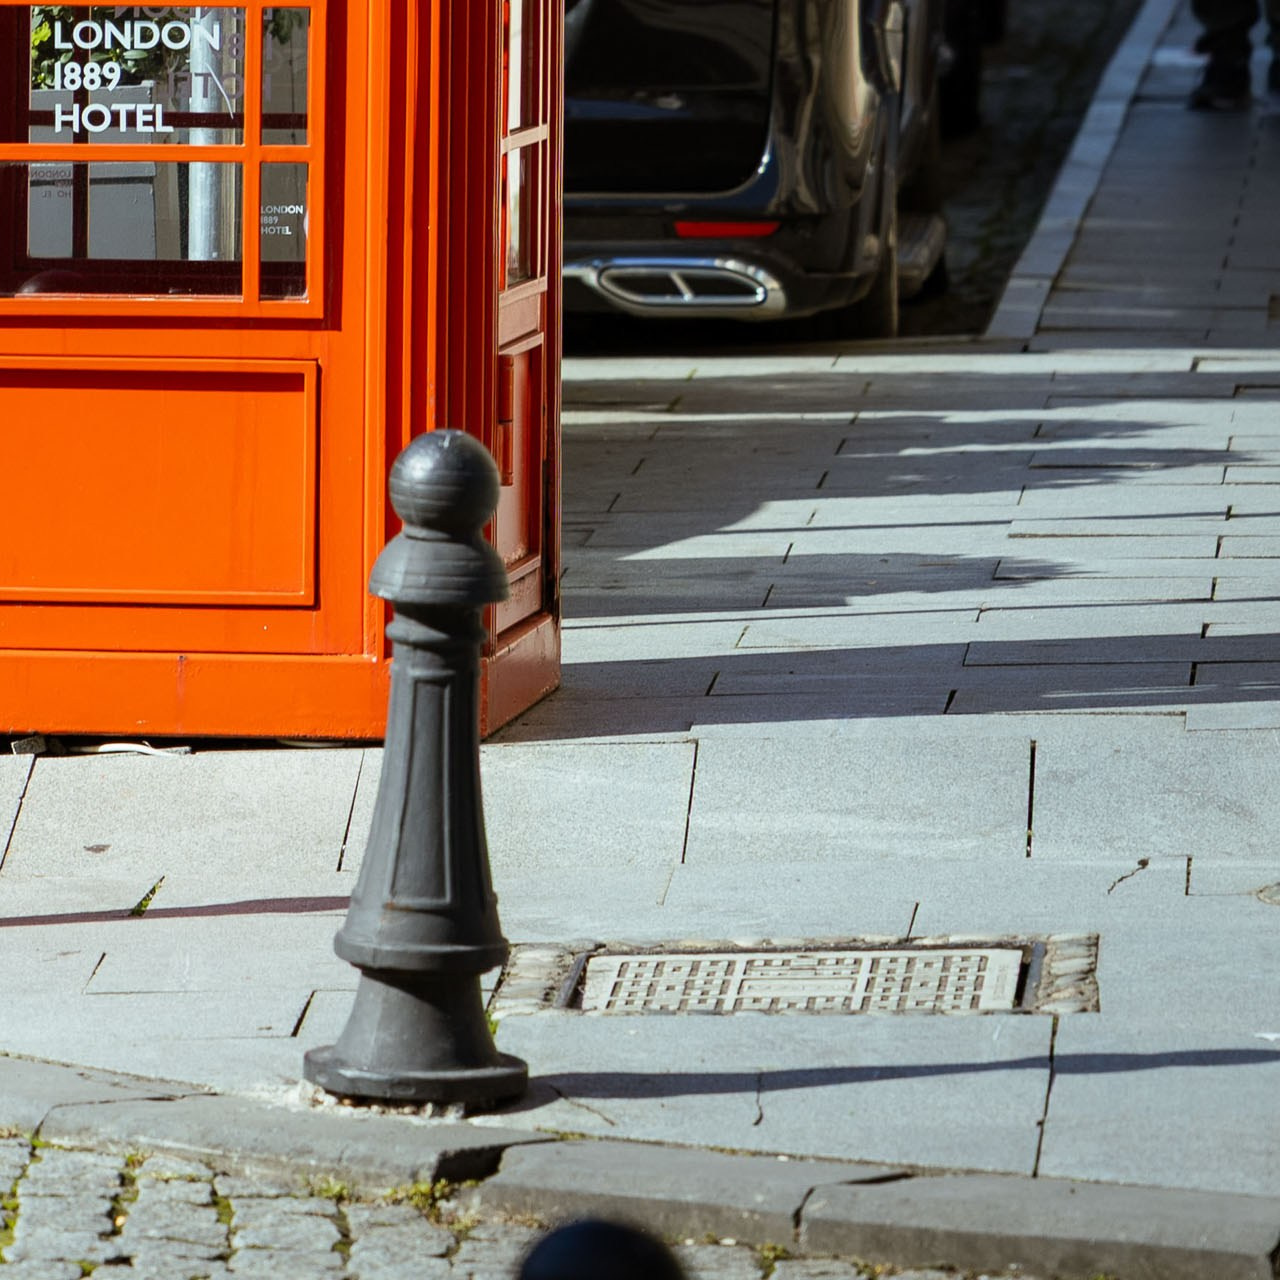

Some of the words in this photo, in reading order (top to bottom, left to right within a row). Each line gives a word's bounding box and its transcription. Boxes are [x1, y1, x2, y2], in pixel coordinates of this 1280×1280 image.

[54, 20, 220, 51] LONDON
[54, 61, 121, 92] 1889
[54, 103, 174, 133] HOTEL
[261, 204, 304, 214] LONDON
[261, 225, 292, 235] HOTEL
